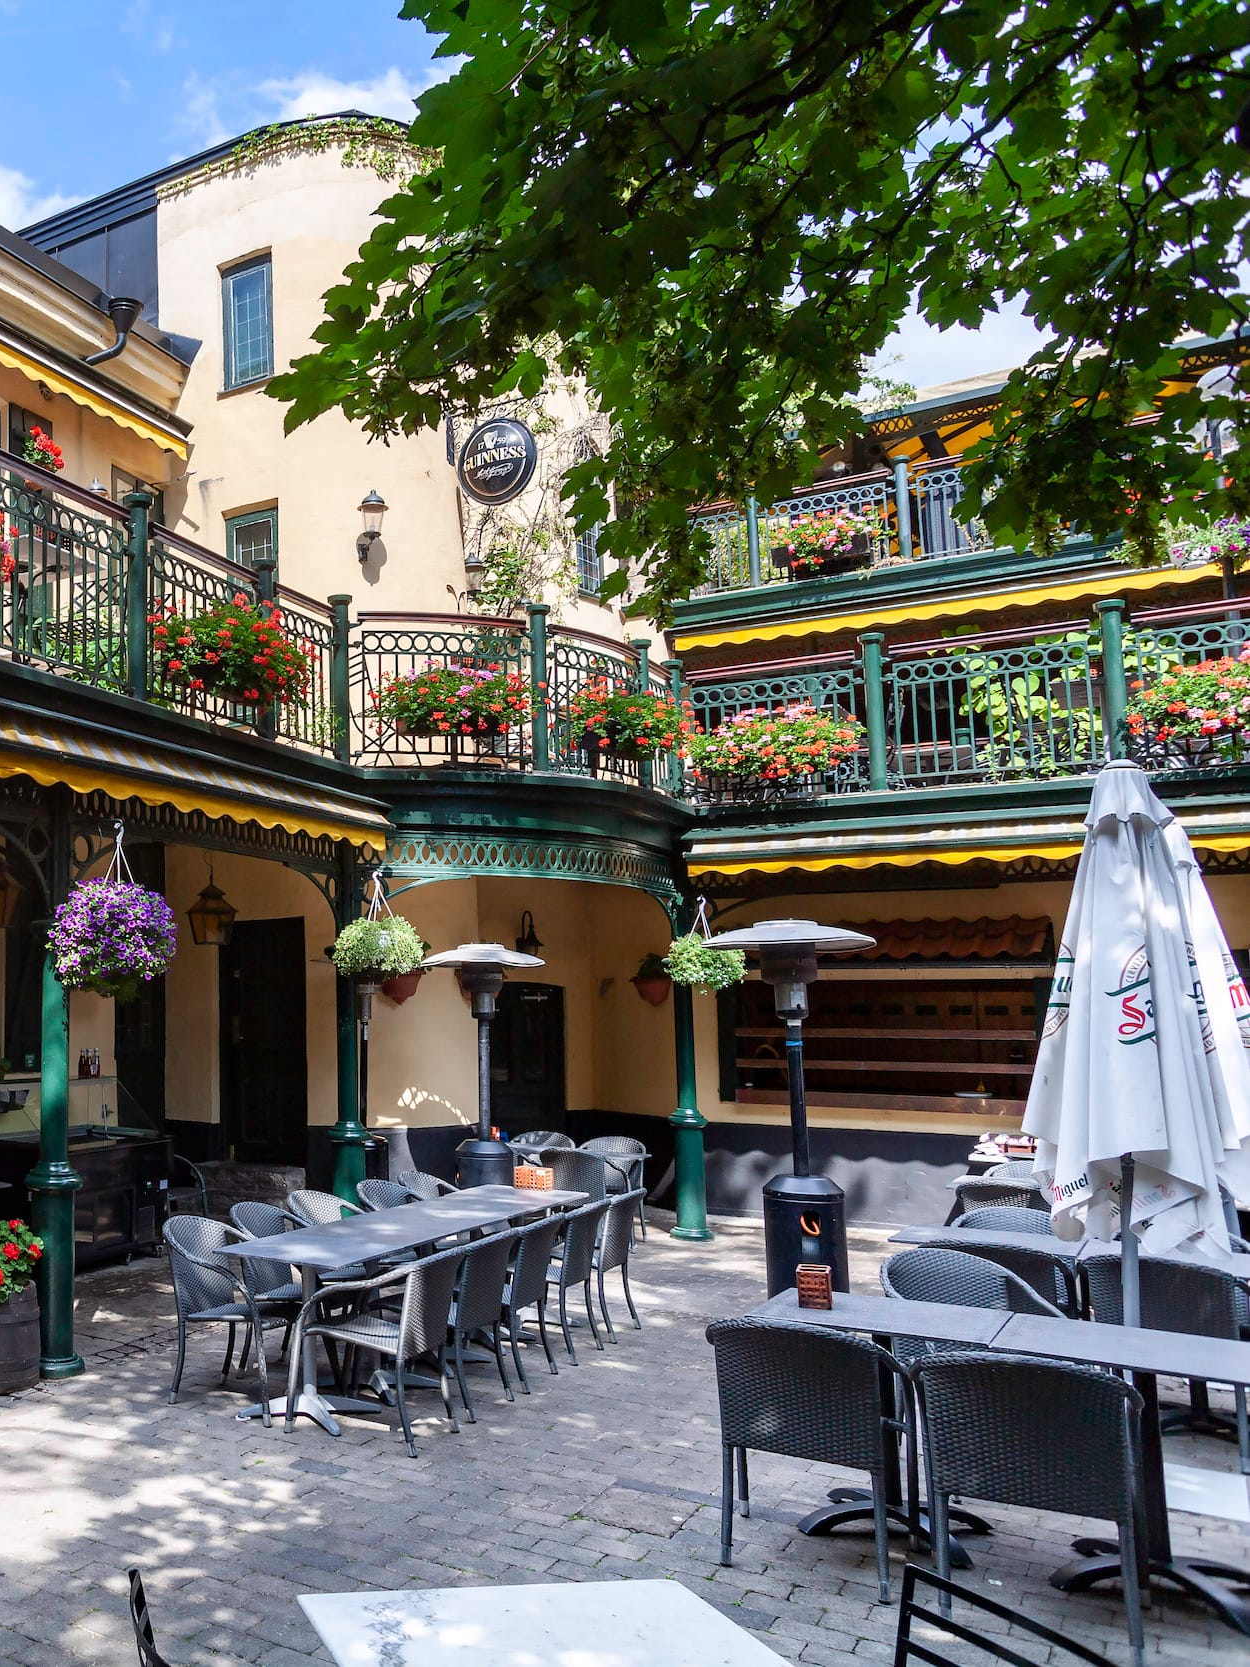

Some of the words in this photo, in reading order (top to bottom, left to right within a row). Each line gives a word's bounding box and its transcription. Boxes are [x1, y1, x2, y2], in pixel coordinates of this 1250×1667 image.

[496, 436, 507, 445] 59
[463, 445, 527, 472] GUINNESS
[1053, 1172, 1089, 1201] Miguel
